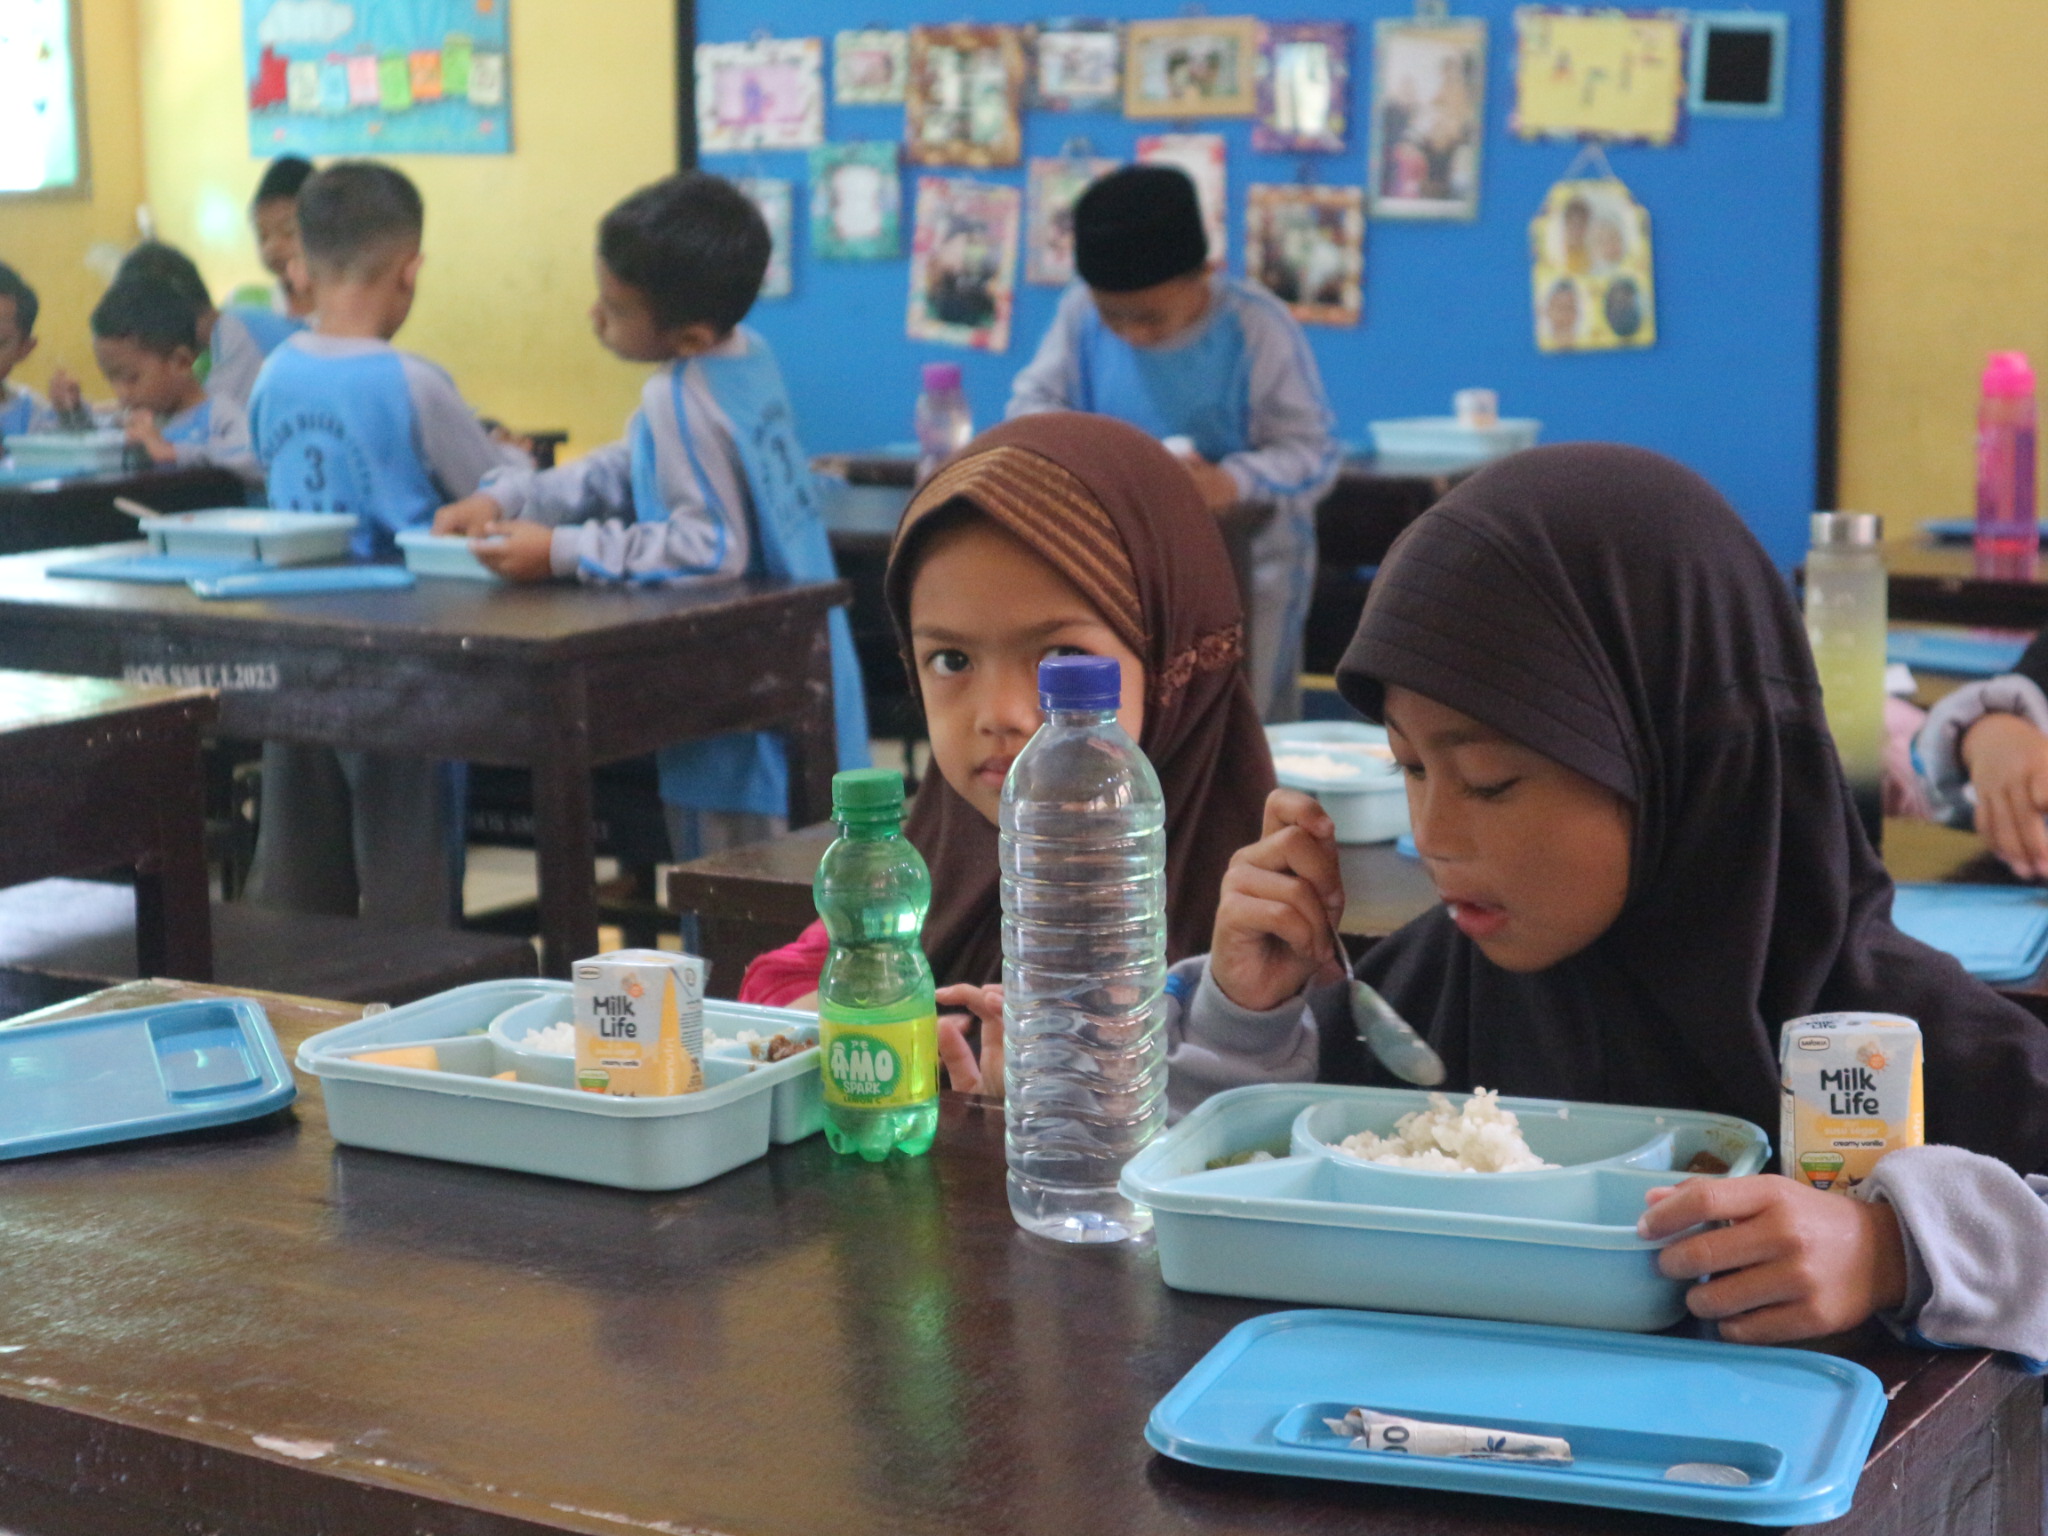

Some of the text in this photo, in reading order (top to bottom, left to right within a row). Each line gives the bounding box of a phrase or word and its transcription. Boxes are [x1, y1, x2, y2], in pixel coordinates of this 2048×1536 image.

[593, 995, 636, 1016] Milk
[600, 1017, 637, 1038] Life
[843, 1081, 880, 1095] SPARK
[1820, 1068, 1877, 1091] Milk
[1830, 1092, 1879, 1115] Life
[1833, 1140, 1860, 1148] creamy
